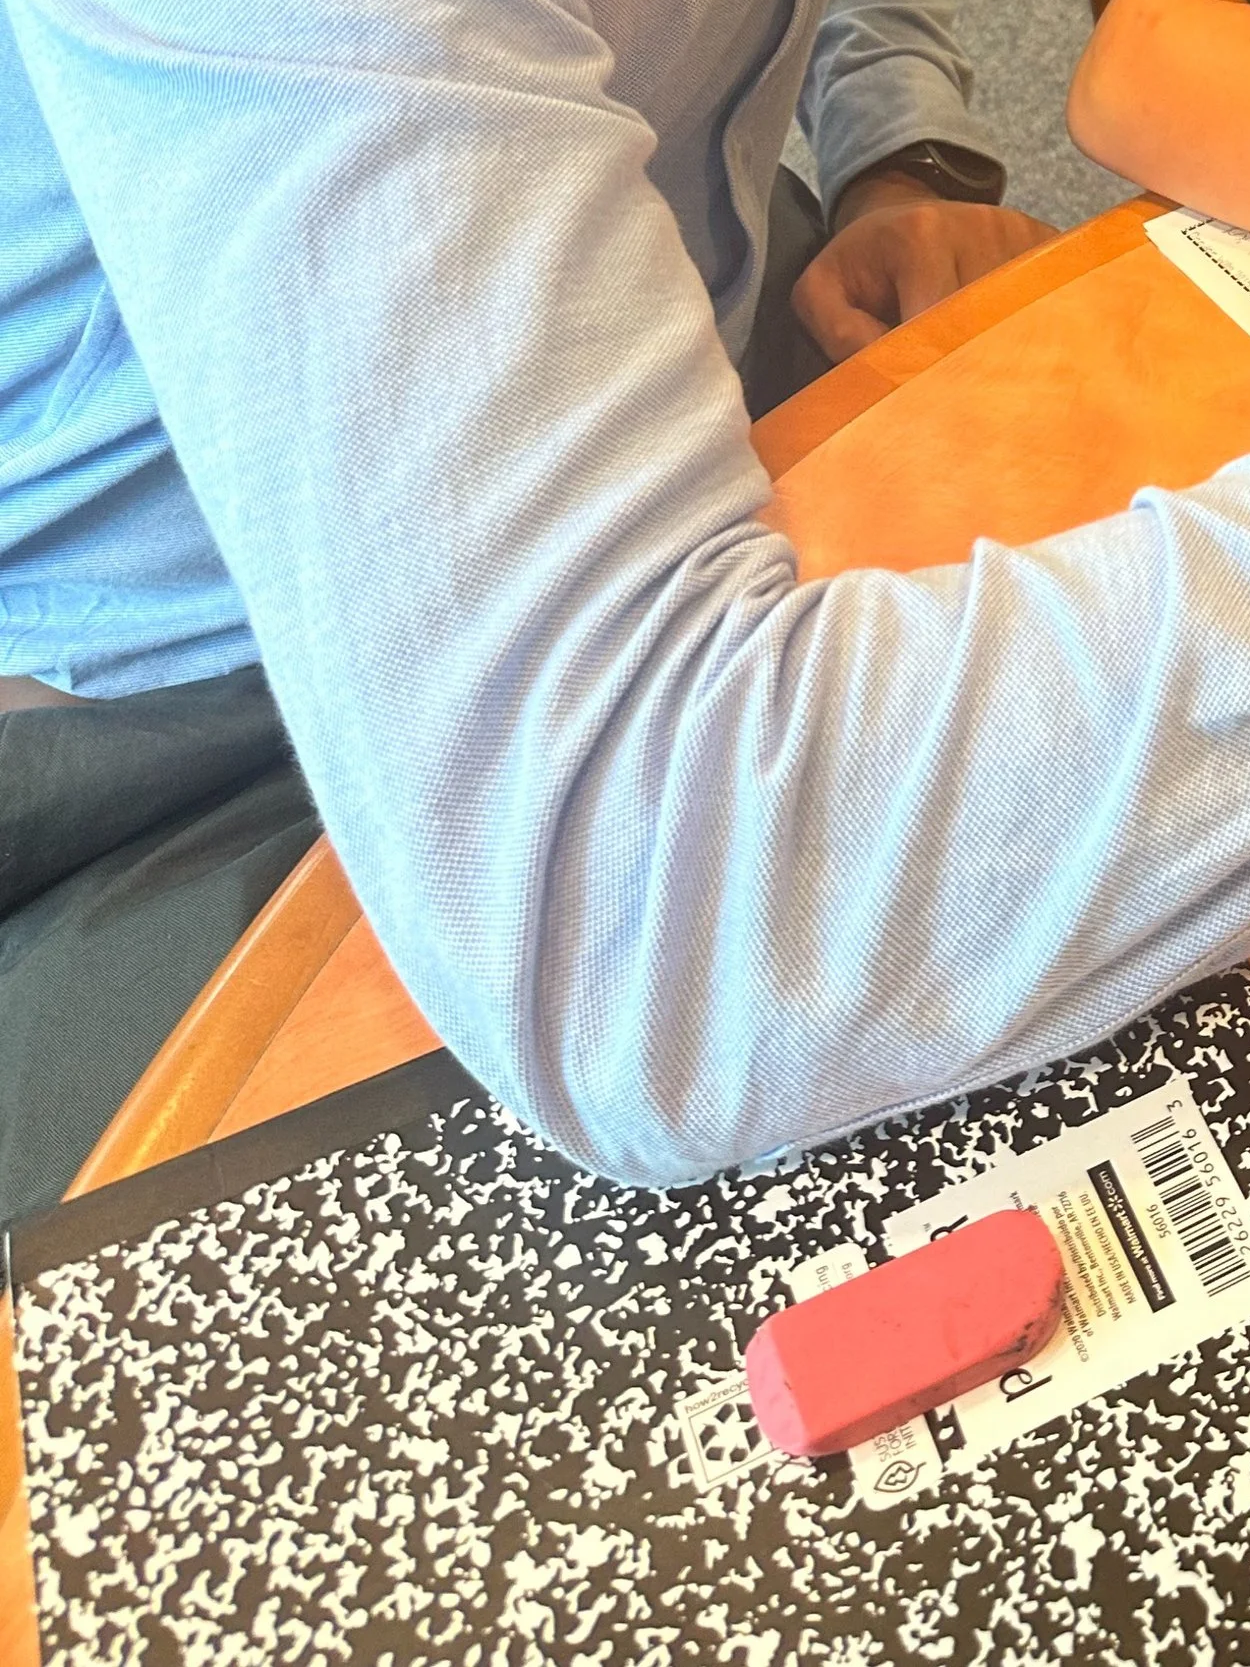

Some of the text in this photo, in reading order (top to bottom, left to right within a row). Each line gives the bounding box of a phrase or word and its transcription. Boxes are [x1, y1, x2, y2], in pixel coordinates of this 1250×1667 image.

[1166, 1099, 1183, 1112] 3
[1182, 1128, 1221, 1187] 56016
[1056, 1190, 1073, 1212] 72716
[1065, 1210, 1078, 1223] AR
[1088, 1214, 1101, 1227] EN
[1147, 1203, 1171, 1239] 56016
[1139, 1255, 1149, 1265] at
[1114, 1269, 1126, 1280] IN
[1143, 1263, 1158, 1283] more
[1078, 1271, 1108, 1317] Distributed
[1119, 1279, 1137, 1304] MADE
[1150, 1281, 1166, 1301] Find
[1100, 1285, 1123, 1320] Walmart
